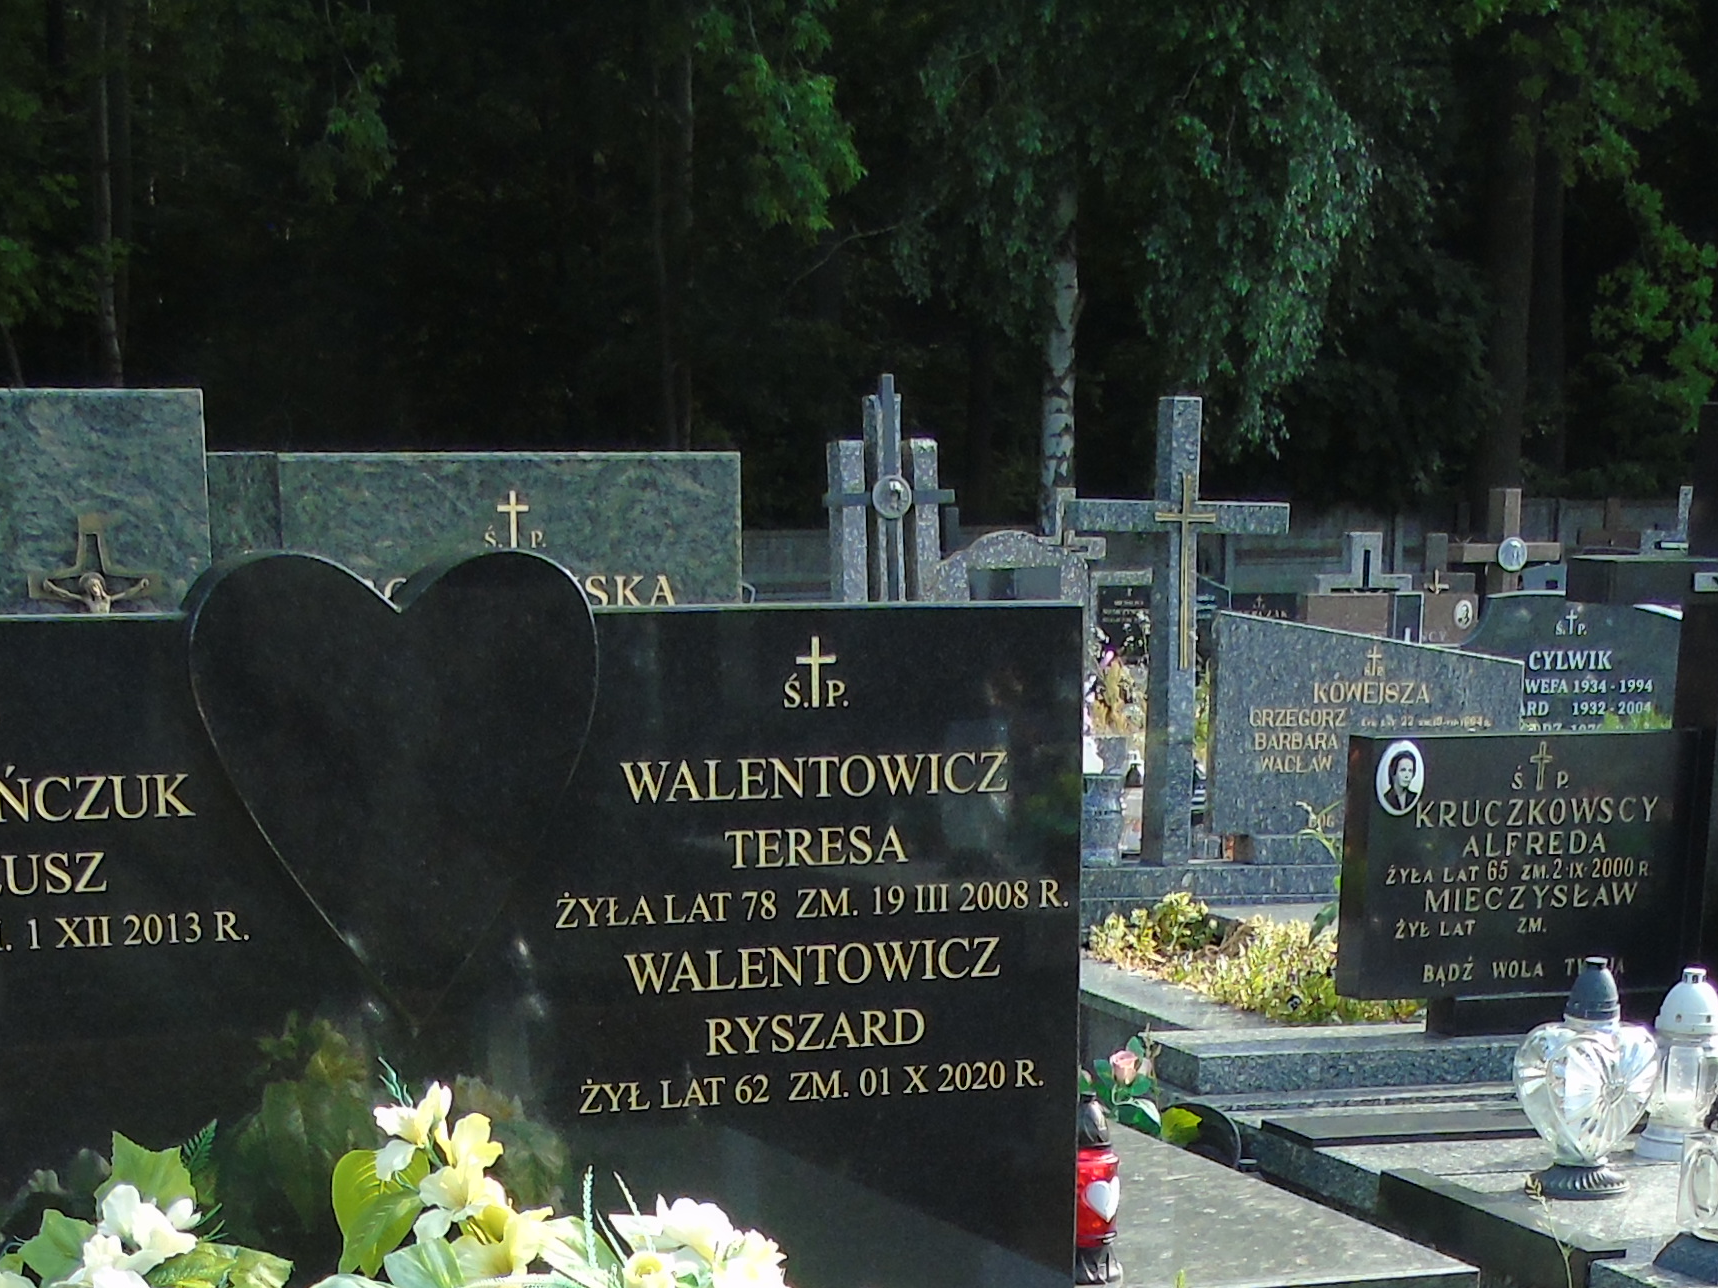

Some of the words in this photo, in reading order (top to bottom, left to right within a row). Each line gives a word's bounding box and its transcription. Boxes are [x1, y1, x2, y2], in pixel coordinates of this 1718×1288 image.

[585, 574, 677, 607] SKA
[1528, 650, 1613, 671] CYLWIK
[783, 674, 809, 709] Ś.
[825, 680, 850, 708] P.
[1524, 678, 1569, 694] WEFA
[1573, 679, 1607, 694] 1934
[1619, 678, 1653, 693] 1994
[1249, 706, 1348, 728] GRZEGORZ
[1572, 701, 1606, 716] 1932
[1254, 732, 1339, 751] BARBARA
[620, 751, 1009, 805] WALENTOWICZ
[1414, 795, 1660, 830] KRUCZKOWSCY
[724, 825, 909, 870] TERESA
[1461, 829, 1608, 859] ALFREDA
[1385, 864, 1434, 886] ŻYŁA
[1442, 866, 1480, 885] LAT
[1486, 859, 1510, 882] 65
[555, 891, 657, 930] ŻYŁA
[663, 892, 732, 925] LAT
[741, 889, 778, 922] 78
[795, 887, 859, 920] ZM.
[872, 884, 906, 917] 19
[914, 883, 950, 914] III
[959, 880, 1029, 913] 2008
[1038, 879, 1070, 909] R.
[1424, 881, 1640, 914] MIECZYSŁAW
[27, 918, 41, 951] 1
[55, 916, 111, 949] XII
[123, 911, 203, 946] 2013
[214, 910, 251, 942] R.
[1394, 917, 1430, 940] ŻYŁ
[1439, 919, 1477, 938] LAT
[1516, 916, 1548, 935] ZM.
[623, 935, 1002, 995] WALENTOWICZ
[1421, 956, 1475, 988] BĄDŹ
[1492, 959, 1545, 980] WOLA
[1564, 956, 1626, 977] TJA
[704, 1007, 927, 1057] RYSZARD
[578, 1077, 651, 1115] ŻYŁ
[659, 1076, 726, 1110] LAT
[734, 1073, 770, 1106] 62
[788, 1070, 850, 1102] ZM.
[858, 1066, 892, 1098] 01
[903, 1065, 930, 1094] X
[936, 1061, 1006, 1092] 2020
[1013, 1059, 1045, 1089] R.
